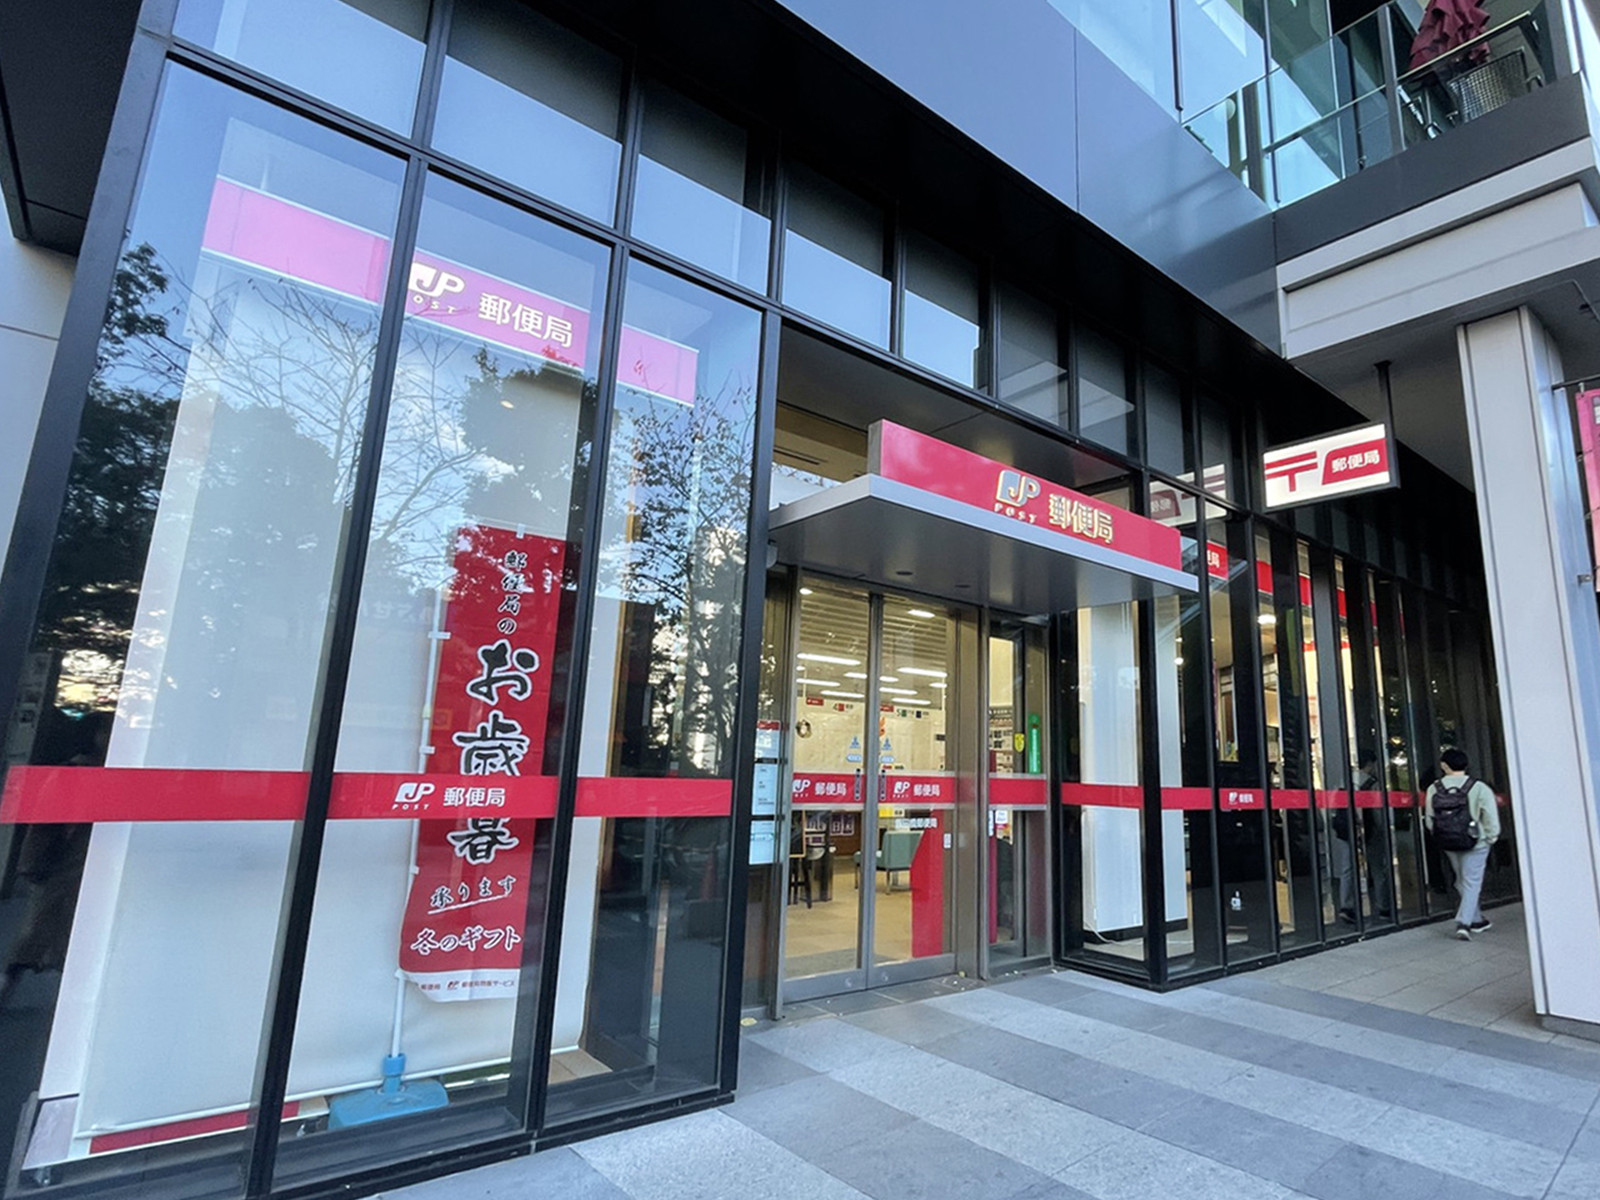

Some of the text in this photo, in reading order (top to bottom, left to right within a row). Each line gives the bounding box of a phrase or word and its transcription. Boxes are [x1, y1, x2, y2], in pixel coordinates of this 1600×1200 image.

[408, 262, 574, 348] JP 郵便局
[412, 295, 456, 315] OST
[1331, 449, 1380, 473] 郵便局
[994, 502, 1037, 524] POST
[996, 470, 1114, 544] JP 郵便局
[497, 549, 528, 635] 郵便局の
[395, 782, 506, 807] JP 郵便局
[815, 782, 847, 796] 郵便局
[913, 783, 940, 797] 郵便局
[392, 803, 430, 811] POST
[430, 875, 516, 909] 承ります
[411, 925, 521, 955] 冬のギフト
